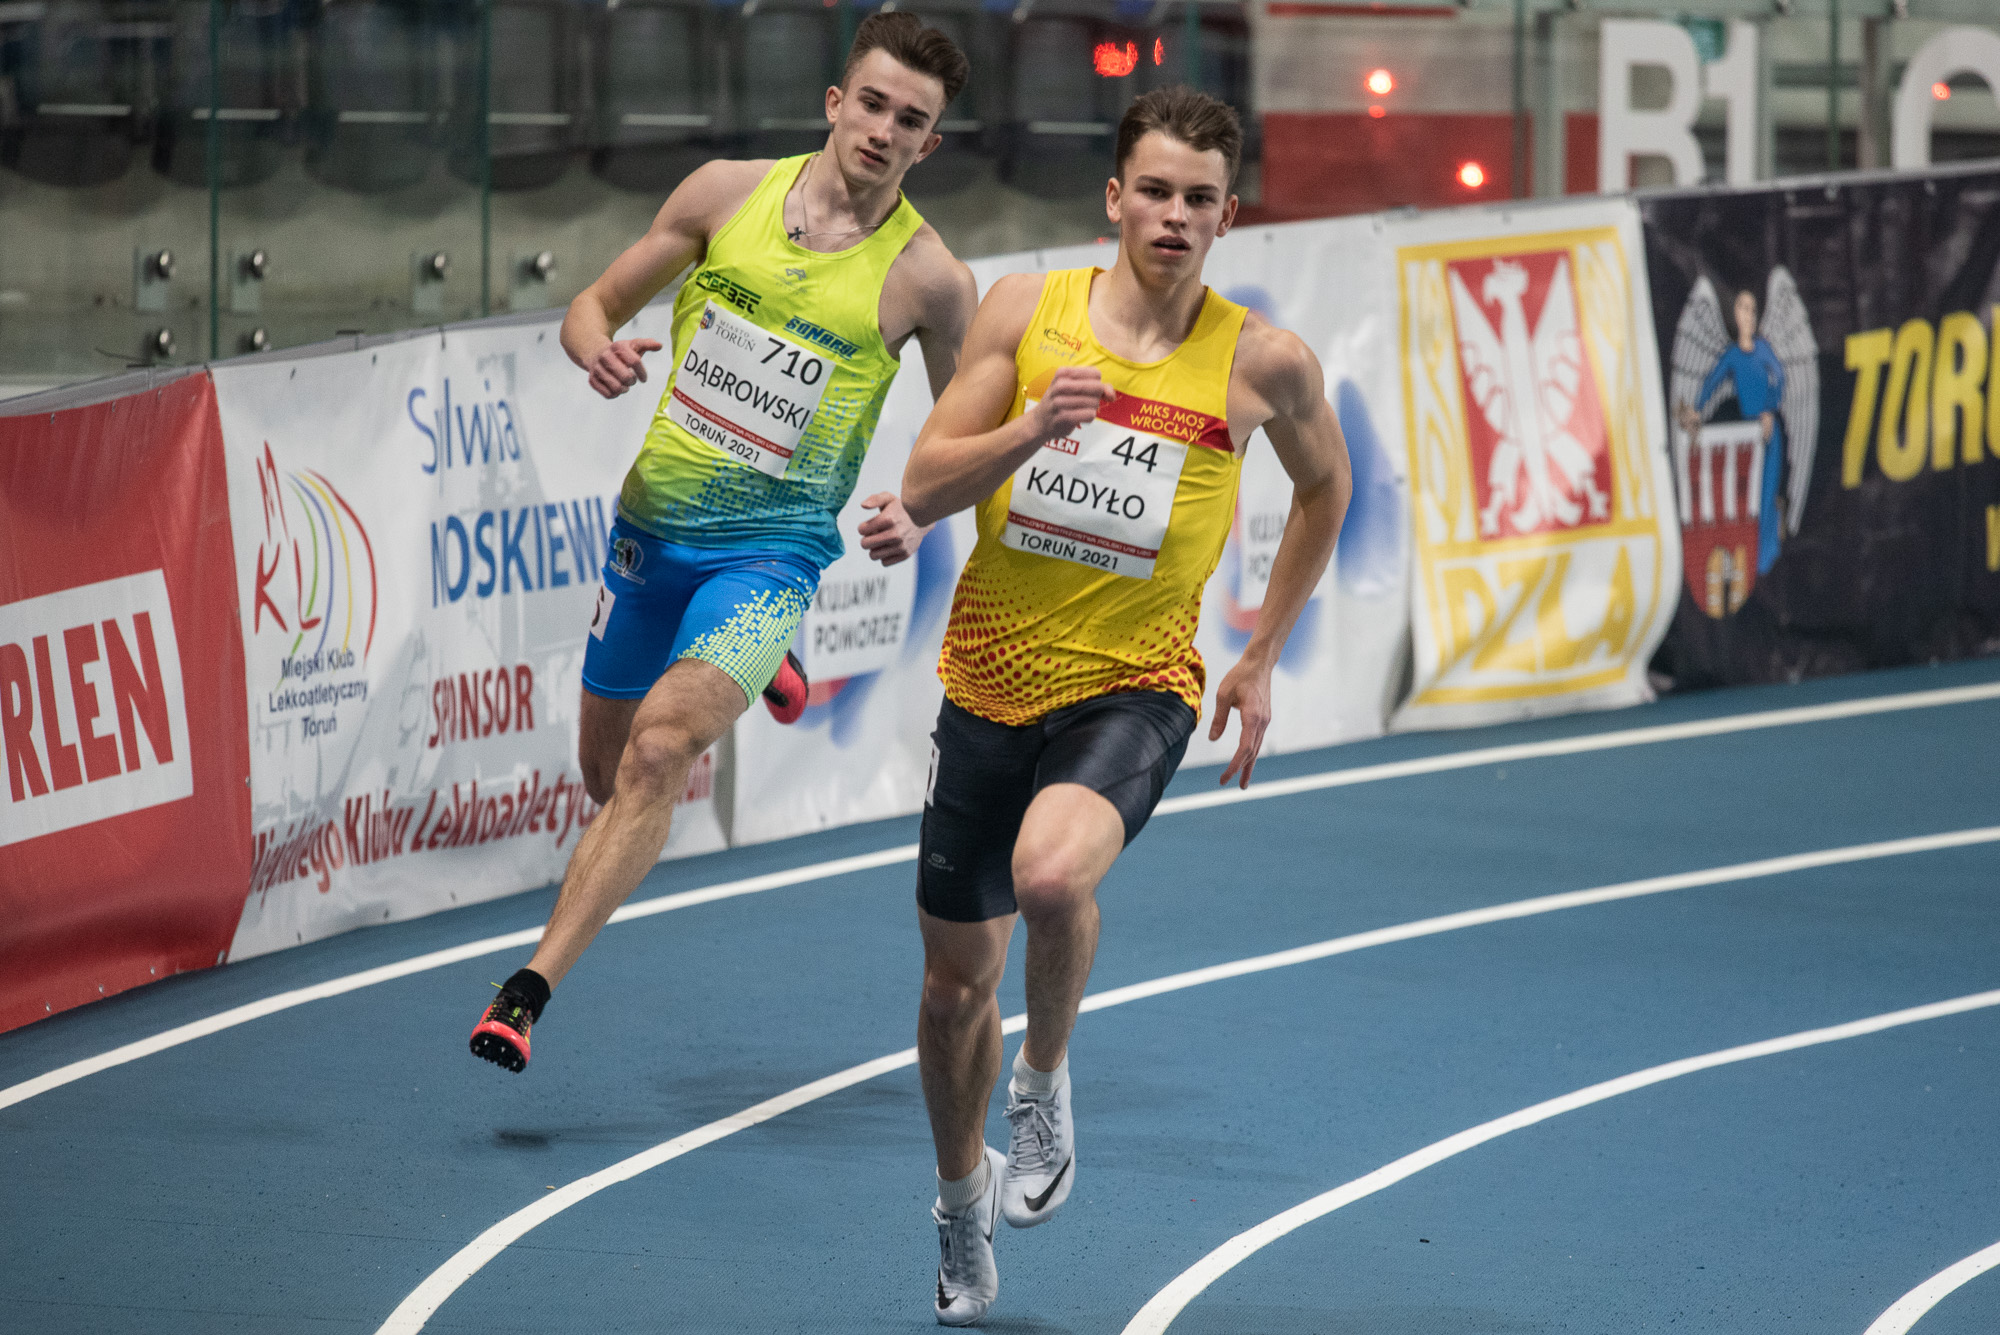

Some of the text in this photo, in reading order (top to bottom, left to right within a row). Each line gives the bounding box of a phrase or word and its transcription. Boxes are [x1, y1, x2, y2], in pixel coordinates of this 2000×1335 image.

[715, 324, 756, 352] TORUŃ
[720, 320, 750, 338] MIASTO
[784, 316, 860, 360] SONAROL
[760, 336, 823, 386] 710
[683, 349, 811, 431] DĄBROWSKI
[1130, 413, 1203, 442] WROCŁAW
[1139, 402, 1206, 430] MKS MOS
[684, 412, 761, 464] TORUŃ 2021
[1045, 437, 1077, 454] LEN
[1111, 435, 1159, 473] 44
[1026, 465, 1145, 520] KADYŁO
[1020, 531, 1120, 571] TORUŃ 2021
[281, 647, 355, 682] Miejski Klub
[0, 611, 175, 804] RLEN
[268, 680, 369, 713] Lekkoatletyczny
[428, 664, 535, 749] SPONSOR
[301, 710, 337, 738] Toruń
